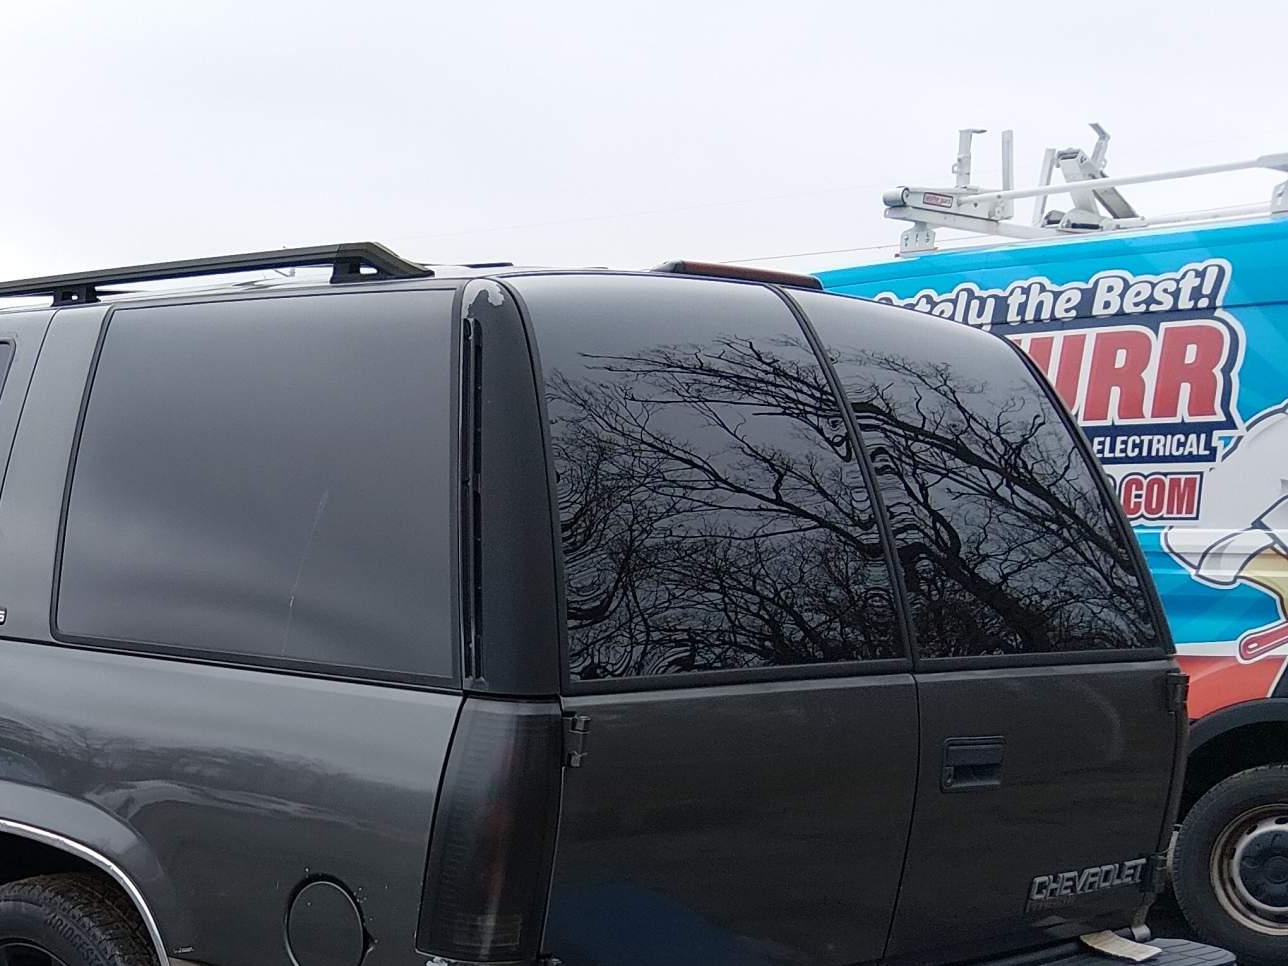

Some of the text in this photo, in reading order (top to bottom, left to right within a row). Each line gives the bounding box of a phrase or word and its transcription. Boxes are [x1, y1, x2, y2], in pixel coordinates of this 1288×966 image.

[1007, 282, 1079, 325] the
[1091, 264, 1219, 317] Best!
[1014, 324, 1225, 422] URR
[1092, 432, 1210, 458] ELECTRICAL
[1031, 858, 1147, 900] CHEVROLET
